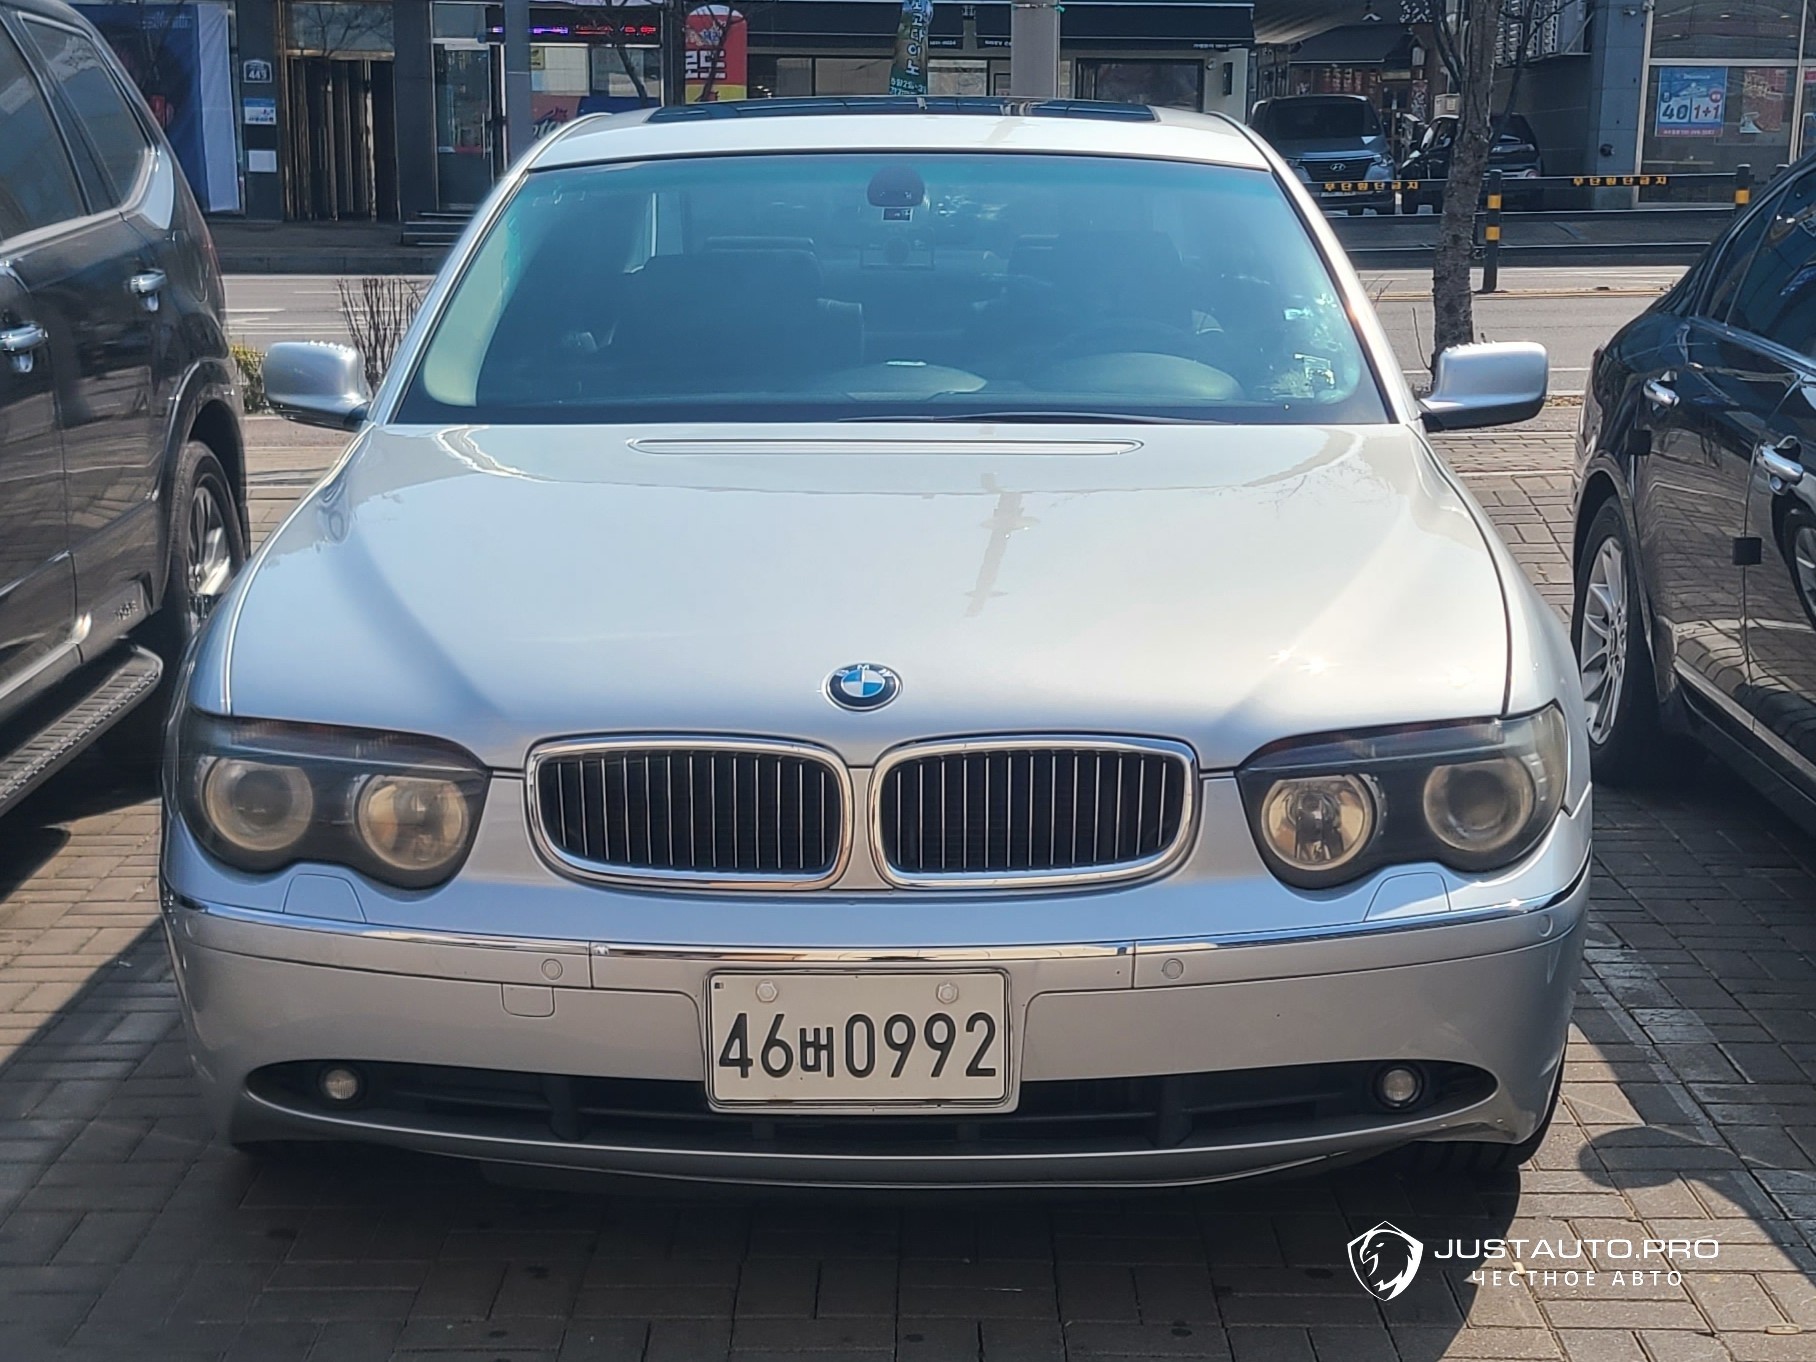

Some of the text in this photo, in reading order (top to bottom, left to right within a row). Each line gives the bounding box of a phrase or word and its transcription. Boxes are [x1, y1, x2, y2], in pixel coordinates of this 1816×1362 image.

[1662, 104, 1689, 120] 40
[1694, 104, 1720, 119] 1+1
[718, 1012, 997, 1078] 46버0992
